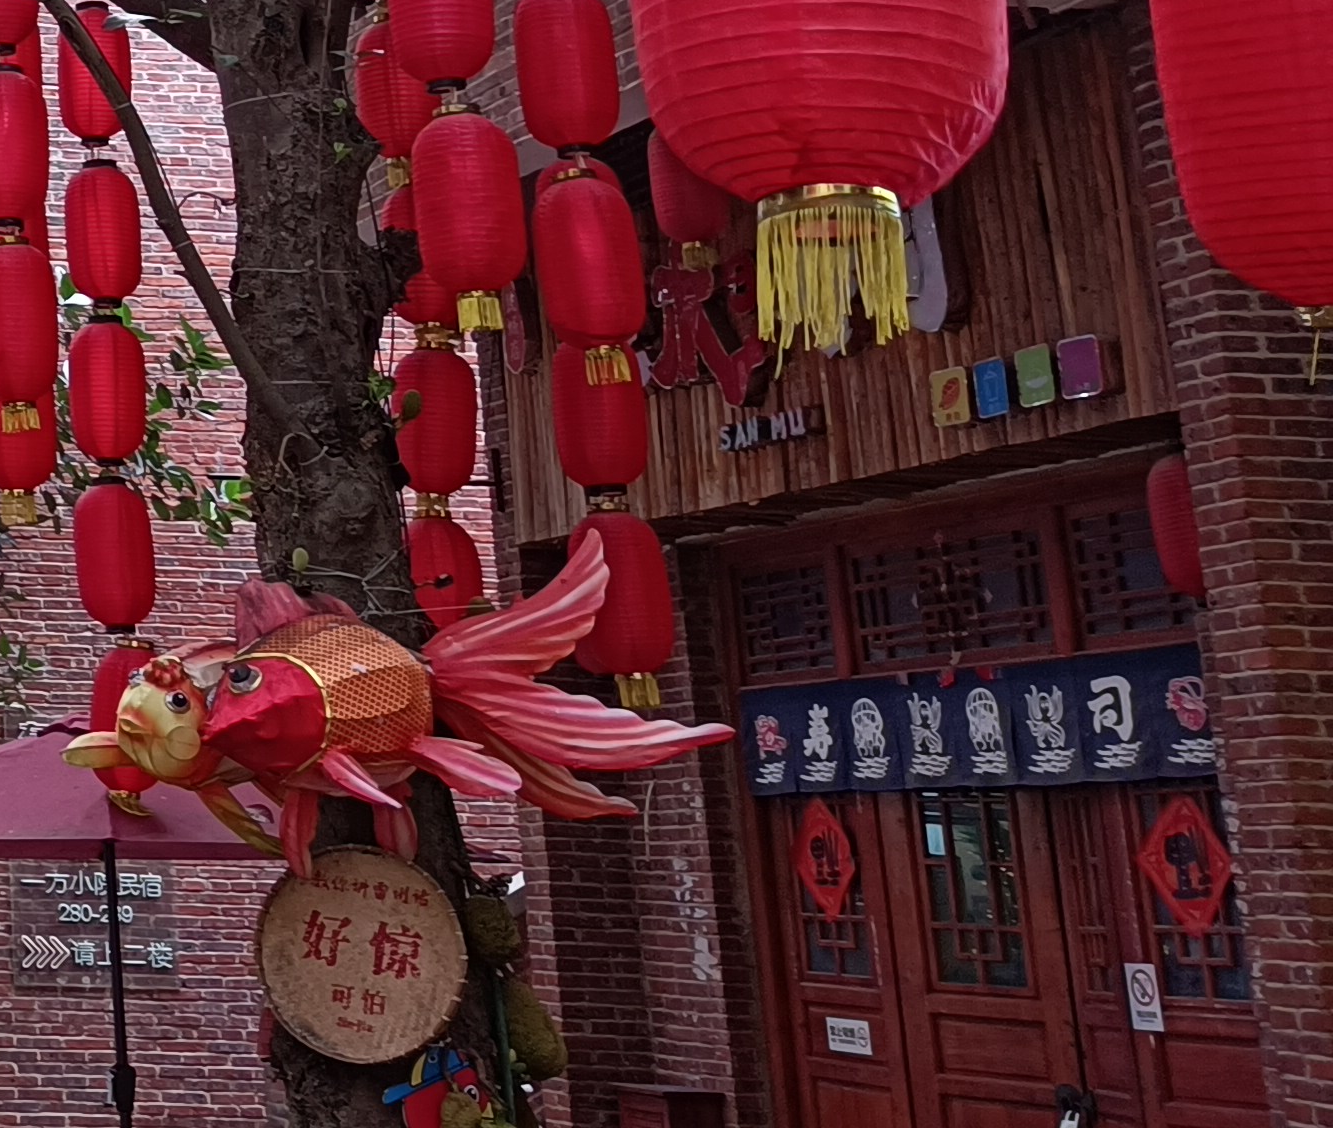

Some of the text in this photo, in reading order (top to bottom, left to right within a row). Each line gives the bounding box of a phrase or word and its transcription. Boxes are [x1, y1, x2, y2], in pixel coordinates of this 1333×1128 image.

[719, 407, 806, 452] SAN MU
[1087, 675, 1133, 742] 司
[67, 937, 174, 969] 请上二楼
[302, 909, 424, 980] 好惊
[331, 983, 387, 1016] 可怕
